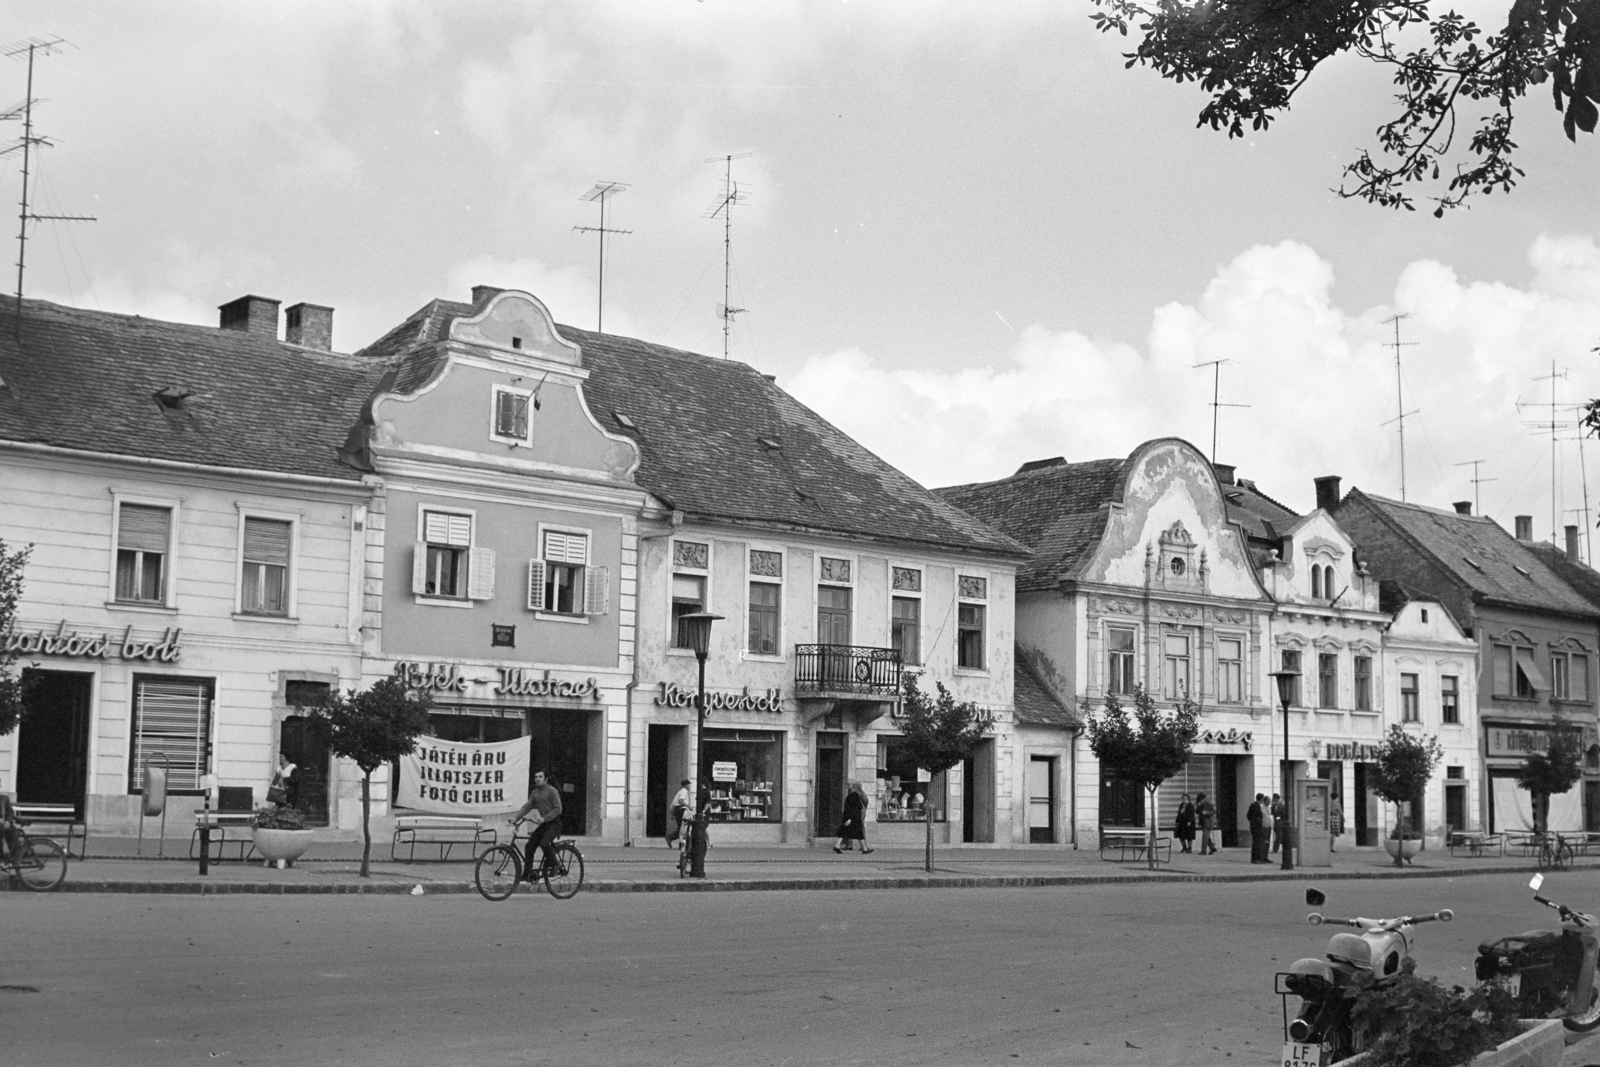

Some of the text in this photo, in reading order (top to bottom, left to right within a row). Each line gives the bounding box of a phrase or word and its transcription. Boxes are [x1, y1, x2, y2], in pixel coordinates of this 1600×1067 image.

[0, 616, 182, 662] tartási bolt
[494, 666, 604, 699] Illatszer
[654, 681, 783, 717] Könyvesbolt
[420, 766, 504, 785] ILLATSZER
[1293, 1045, 1310, 1060] LF
